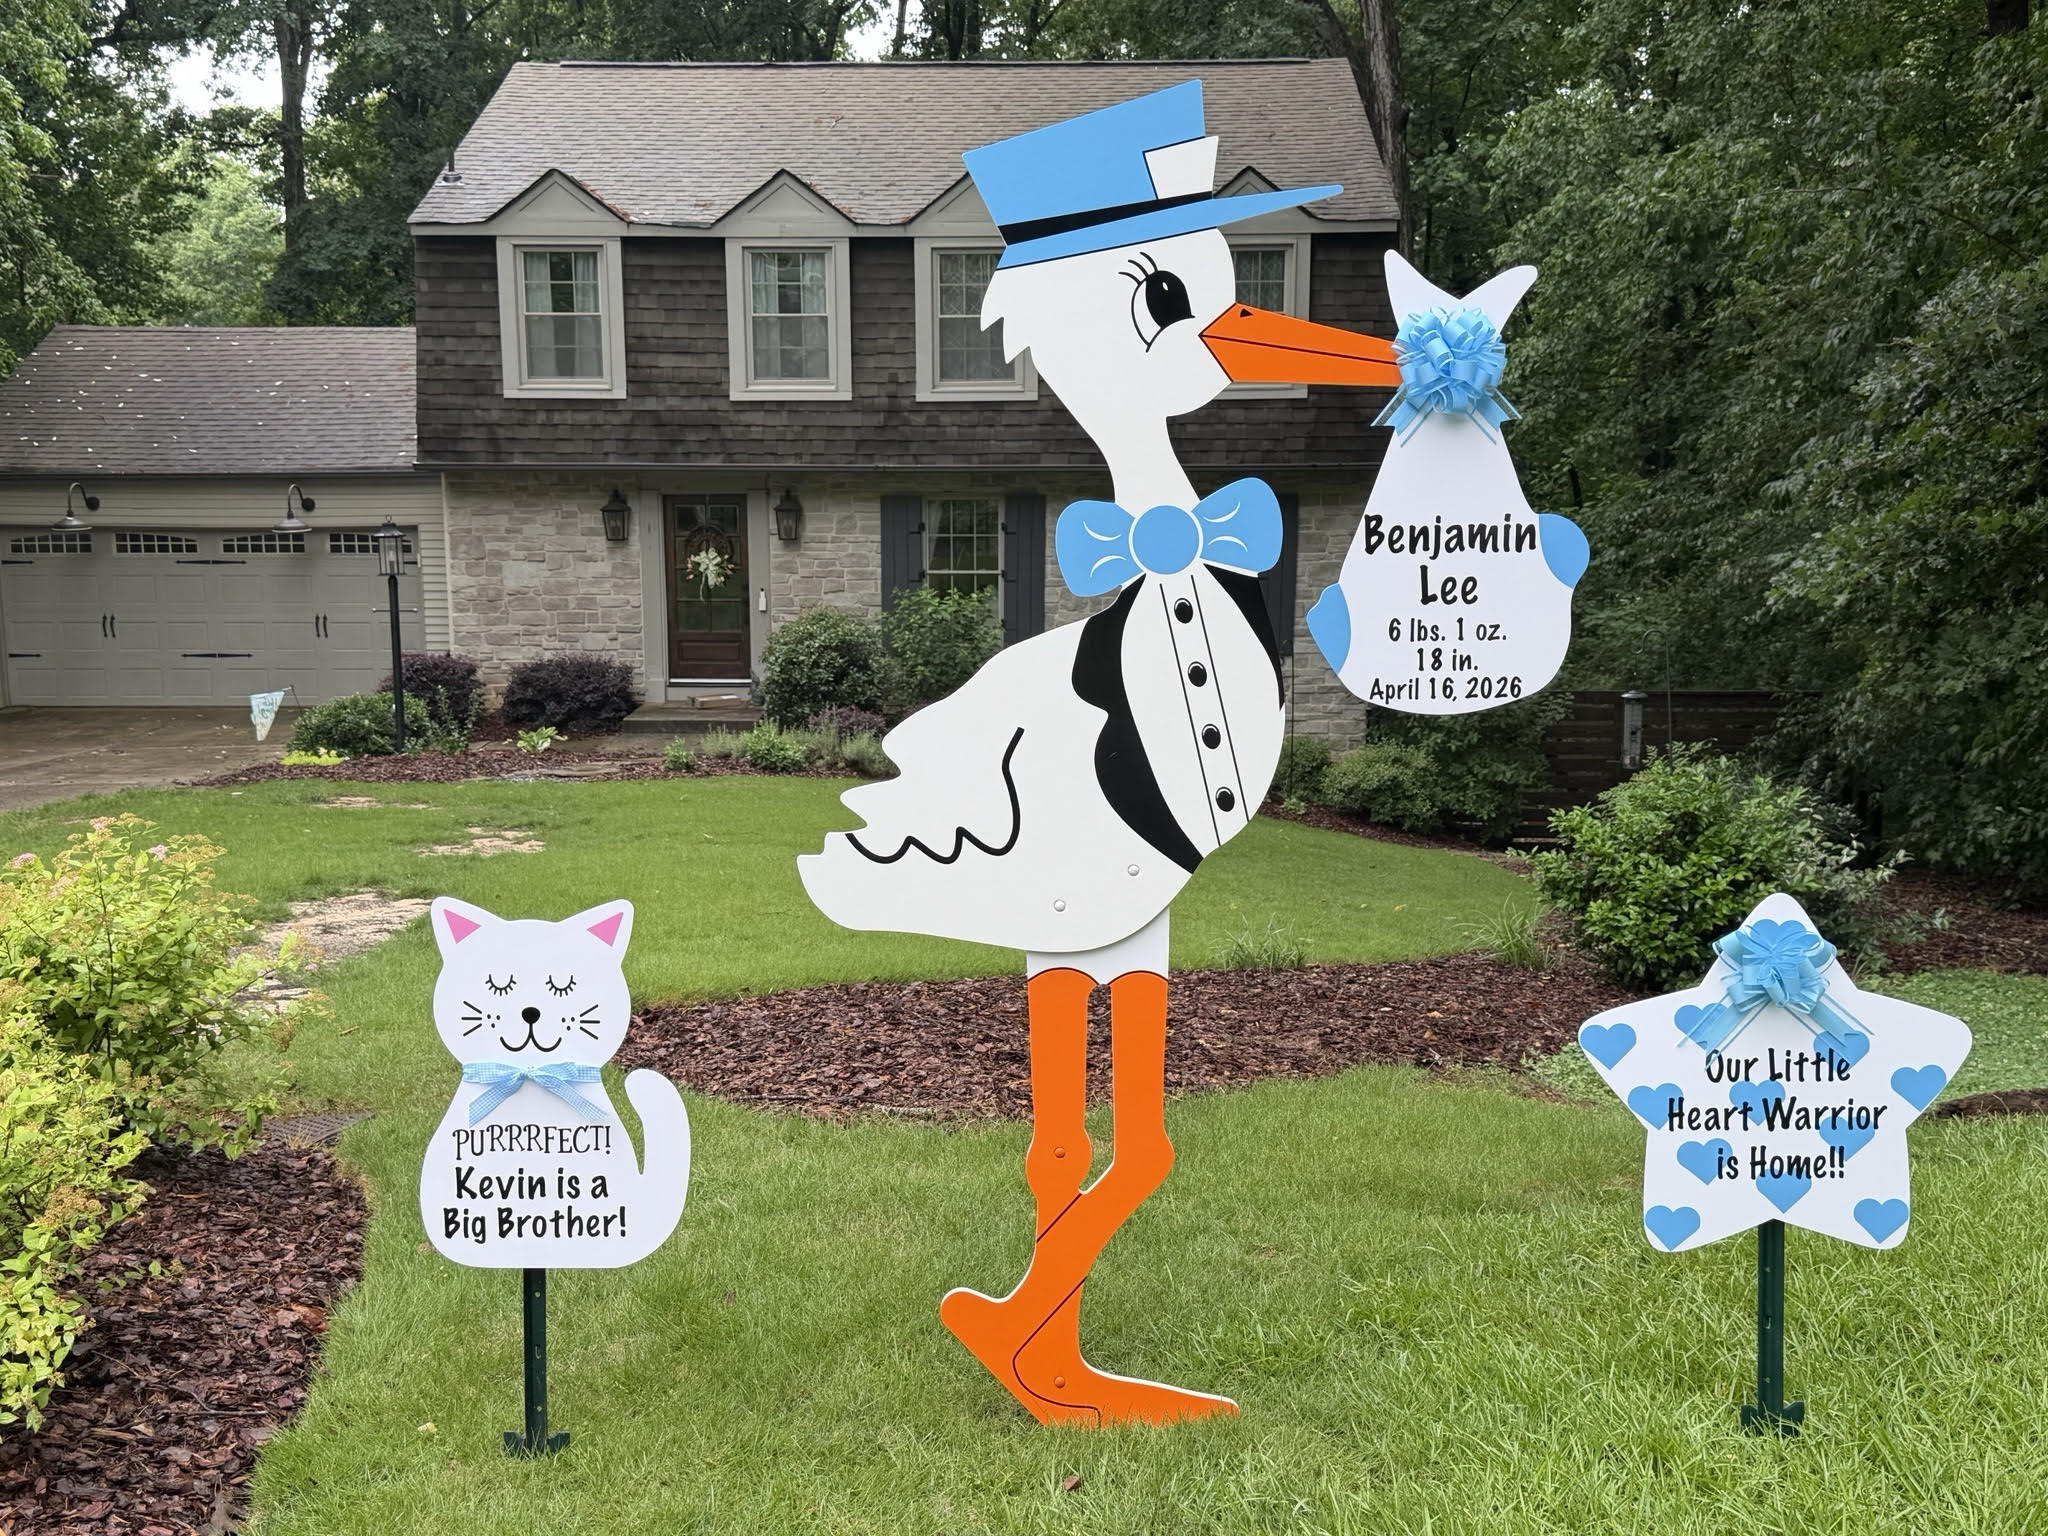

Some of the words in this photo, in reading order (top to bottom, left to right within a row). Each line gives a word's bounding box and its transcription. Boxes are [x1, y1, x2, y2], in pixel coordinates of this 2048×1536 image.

[1363, 512, 1537, 560] Benjamin
[1419, 564, 1478, 606] Lee
[1388, 617, 1402, 642] 6
[1410, 617, 1446, 643] lbs.
[1456, 616, 1464, 641] 1
[1475, 623, 1507, 641] oz.
[1416, 647, 1443, 672] 18
[1452, 648, 1478, 672] in.
[1368, 677, 1420, 705] April
[1429, 677, 1457, 702] 16,
[1463, 676, 1523, 699] 2026
[1705, 1049, 1759, 1084] Our
[1767, 1047, 1851, 1083] Little
[1667, 1096, 1753, 1132] Heart
[1761, 1095, 1888, 1132] Warrior
[452, 1124, 611, 1161] PURRRFECT!
[1717, 1147, 1739, 1180] is
[1749, 1145, 1845, 1180] Home!!
[455, 1165, 547, 1200] Kevin
[557, 1167, 581, 1200] is
[590, 1175, 609, 1199] a
[443, 1207, 486, 1245] Big
[497, 1205, 626, 1239] Brother!
